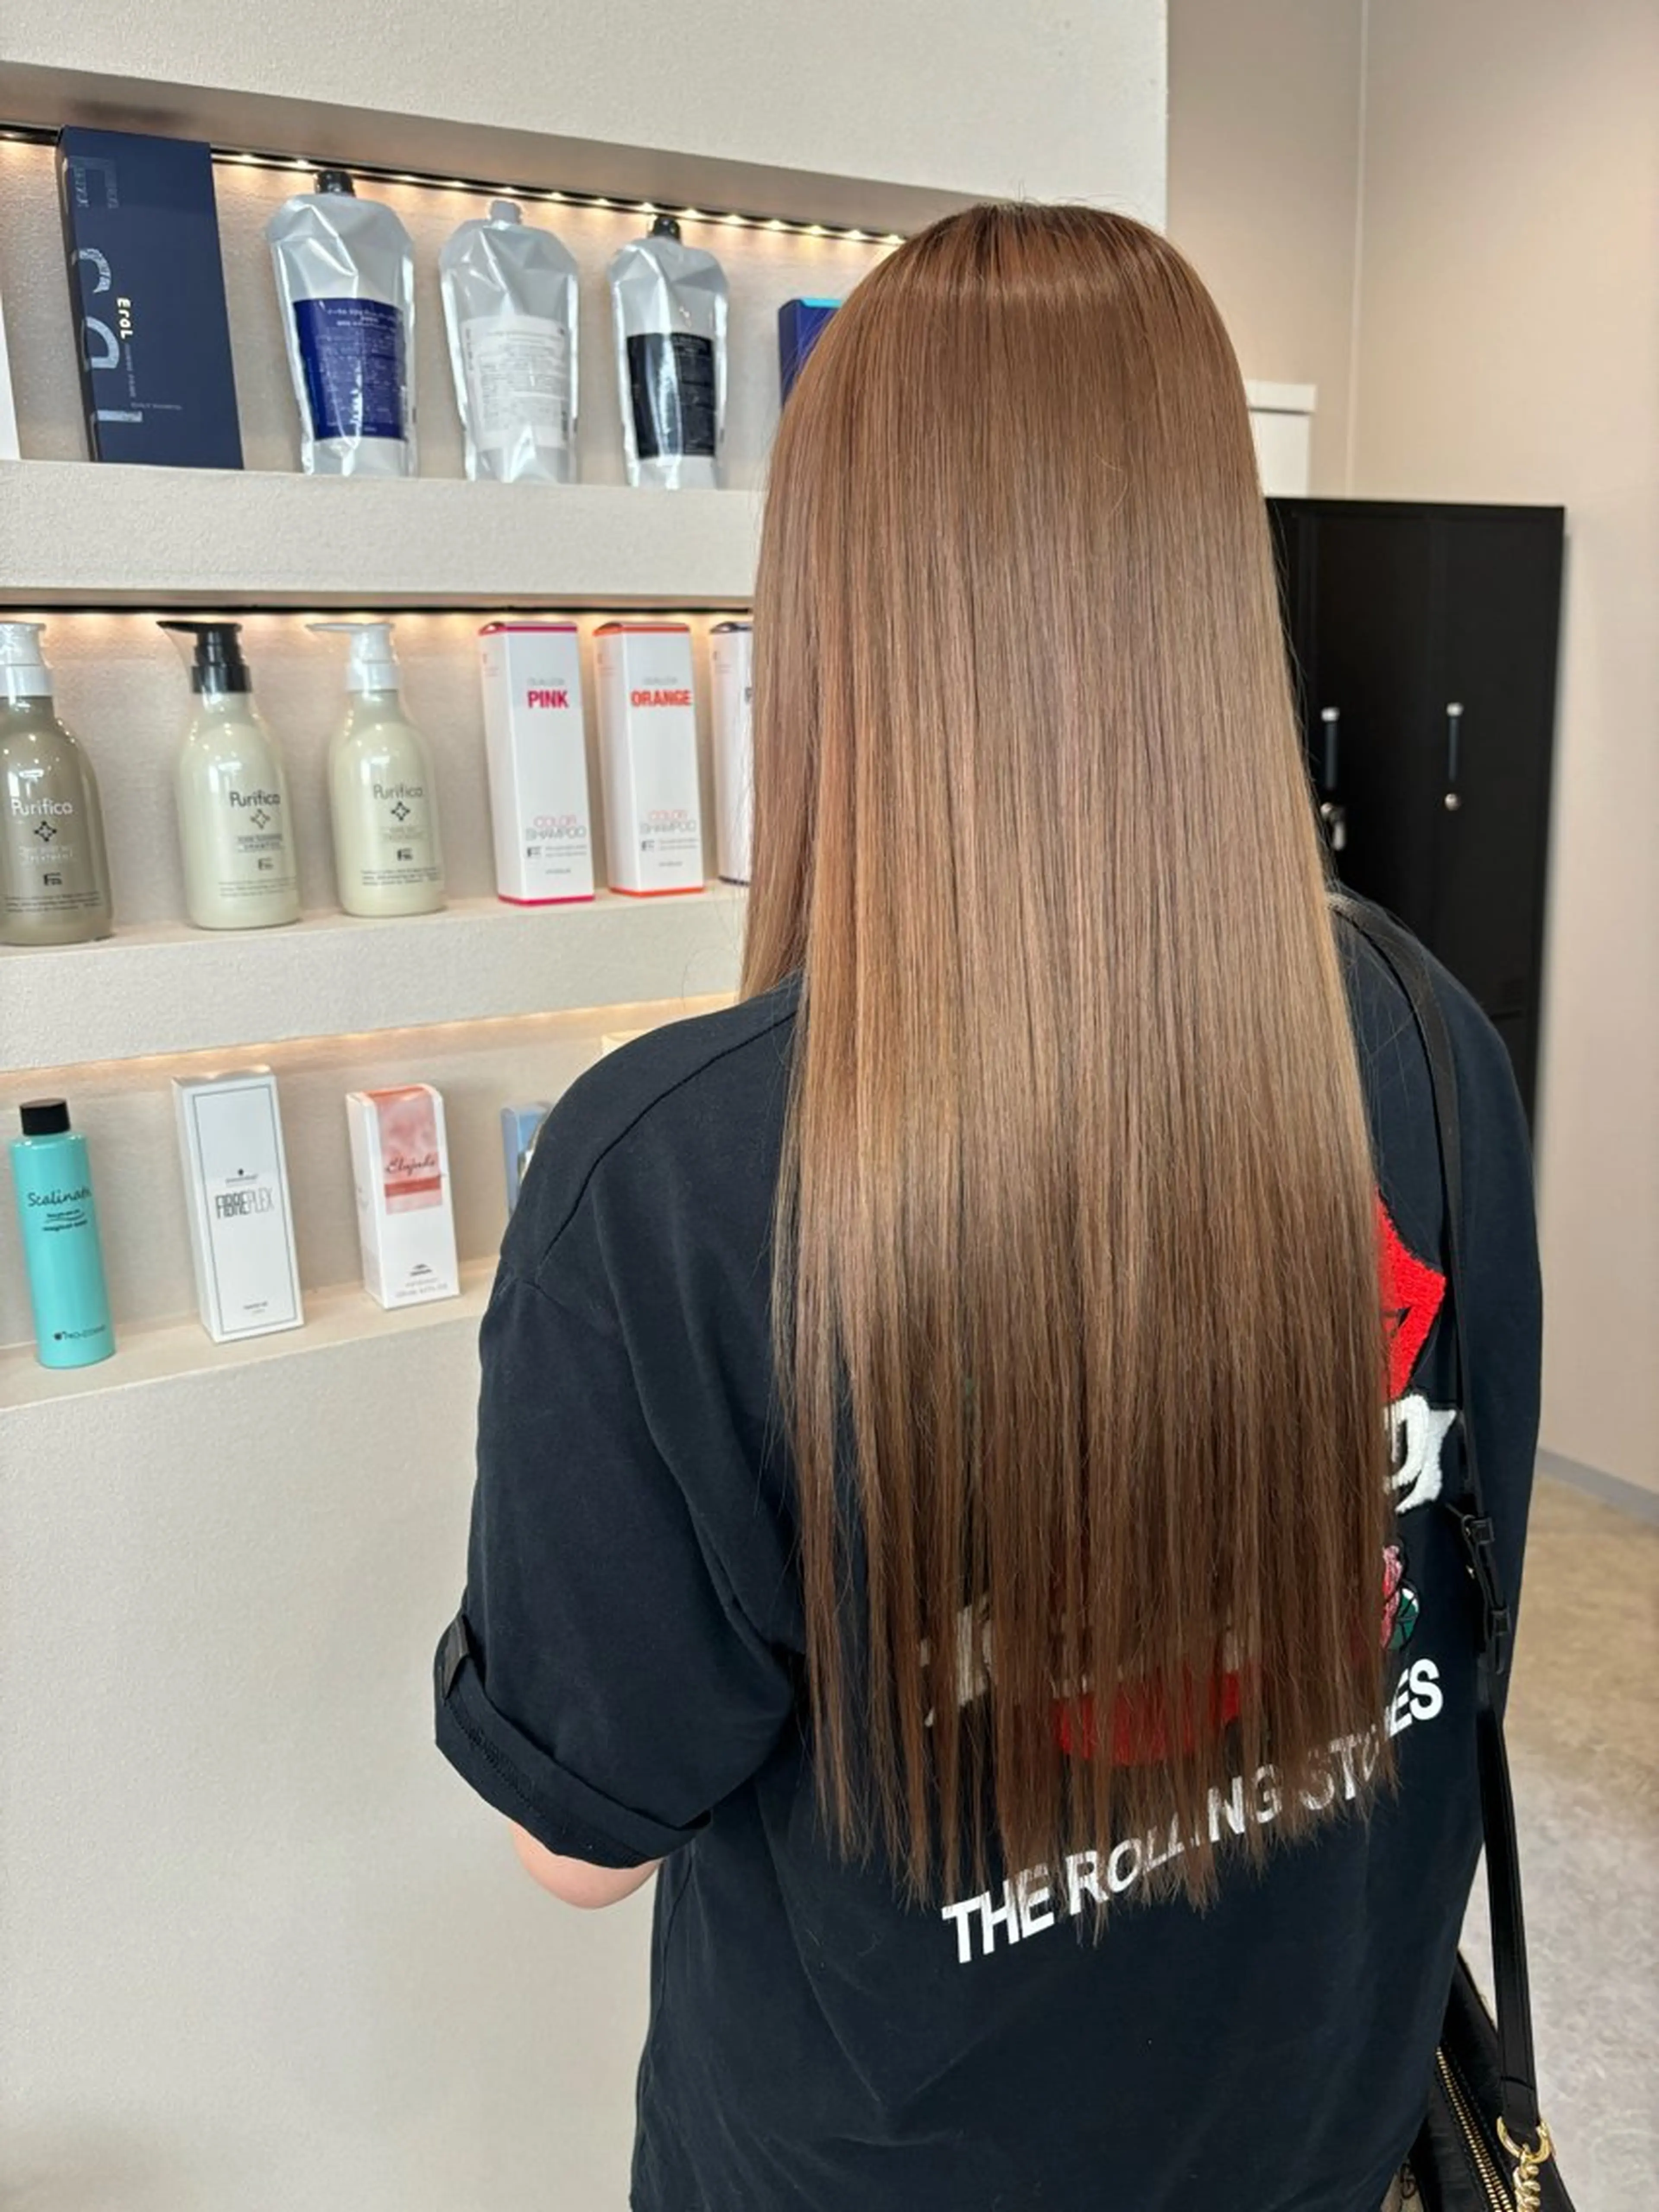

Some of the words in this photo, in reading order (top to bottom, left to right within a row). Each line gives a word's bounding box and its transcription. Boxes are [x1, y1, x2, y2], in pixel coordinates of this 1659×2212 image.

[528, 690, 569, 709] PINK
[631, 690, 692, 707] ORANGE
[941, 1862, 1055, 1964] THE
[1065, 1764, 1282, 1916] ROLLNG
[1298, 1658, 1443, 1811] STES
